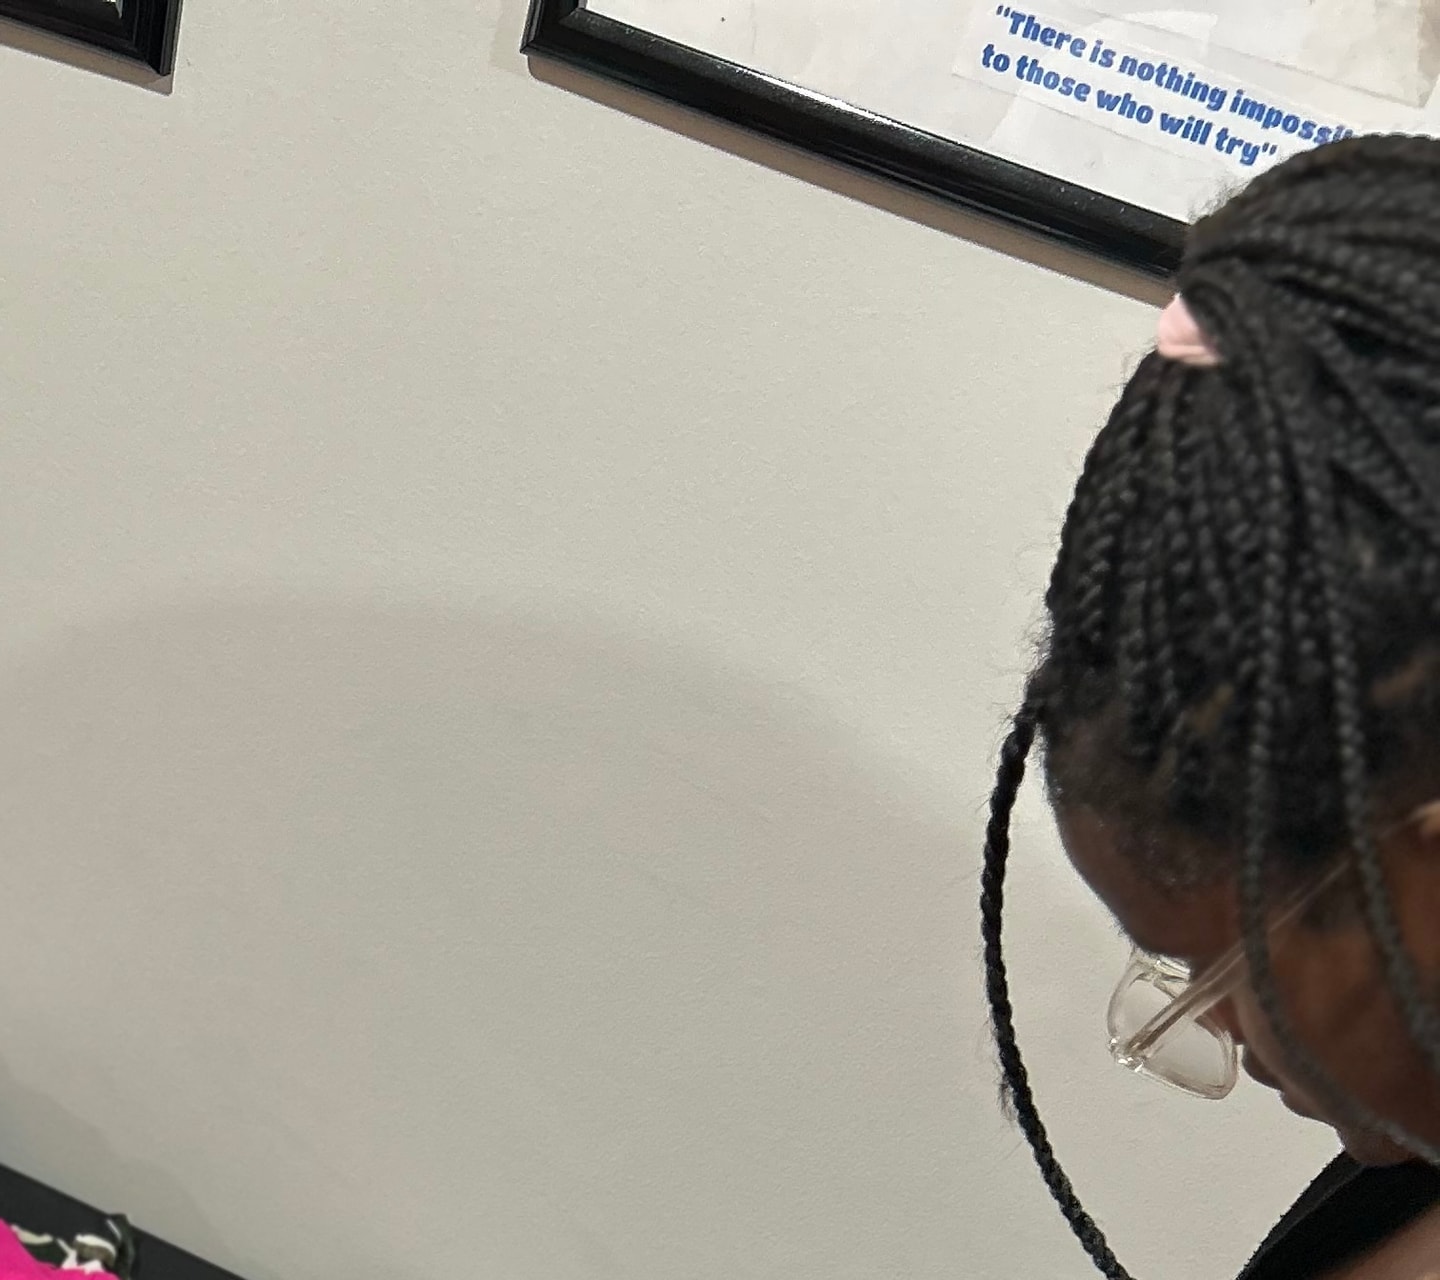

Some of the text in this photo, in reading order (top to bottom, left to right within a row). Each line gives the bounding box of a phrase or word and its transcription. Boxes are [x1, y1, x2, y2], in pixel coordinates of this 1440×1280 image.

[980, 43, 1278, 168] to those who will try"
[995, 4, 1087, 59] "There
[1089, 39, 1114, 67] is
[1118, 53, 1227, 111] nothing
